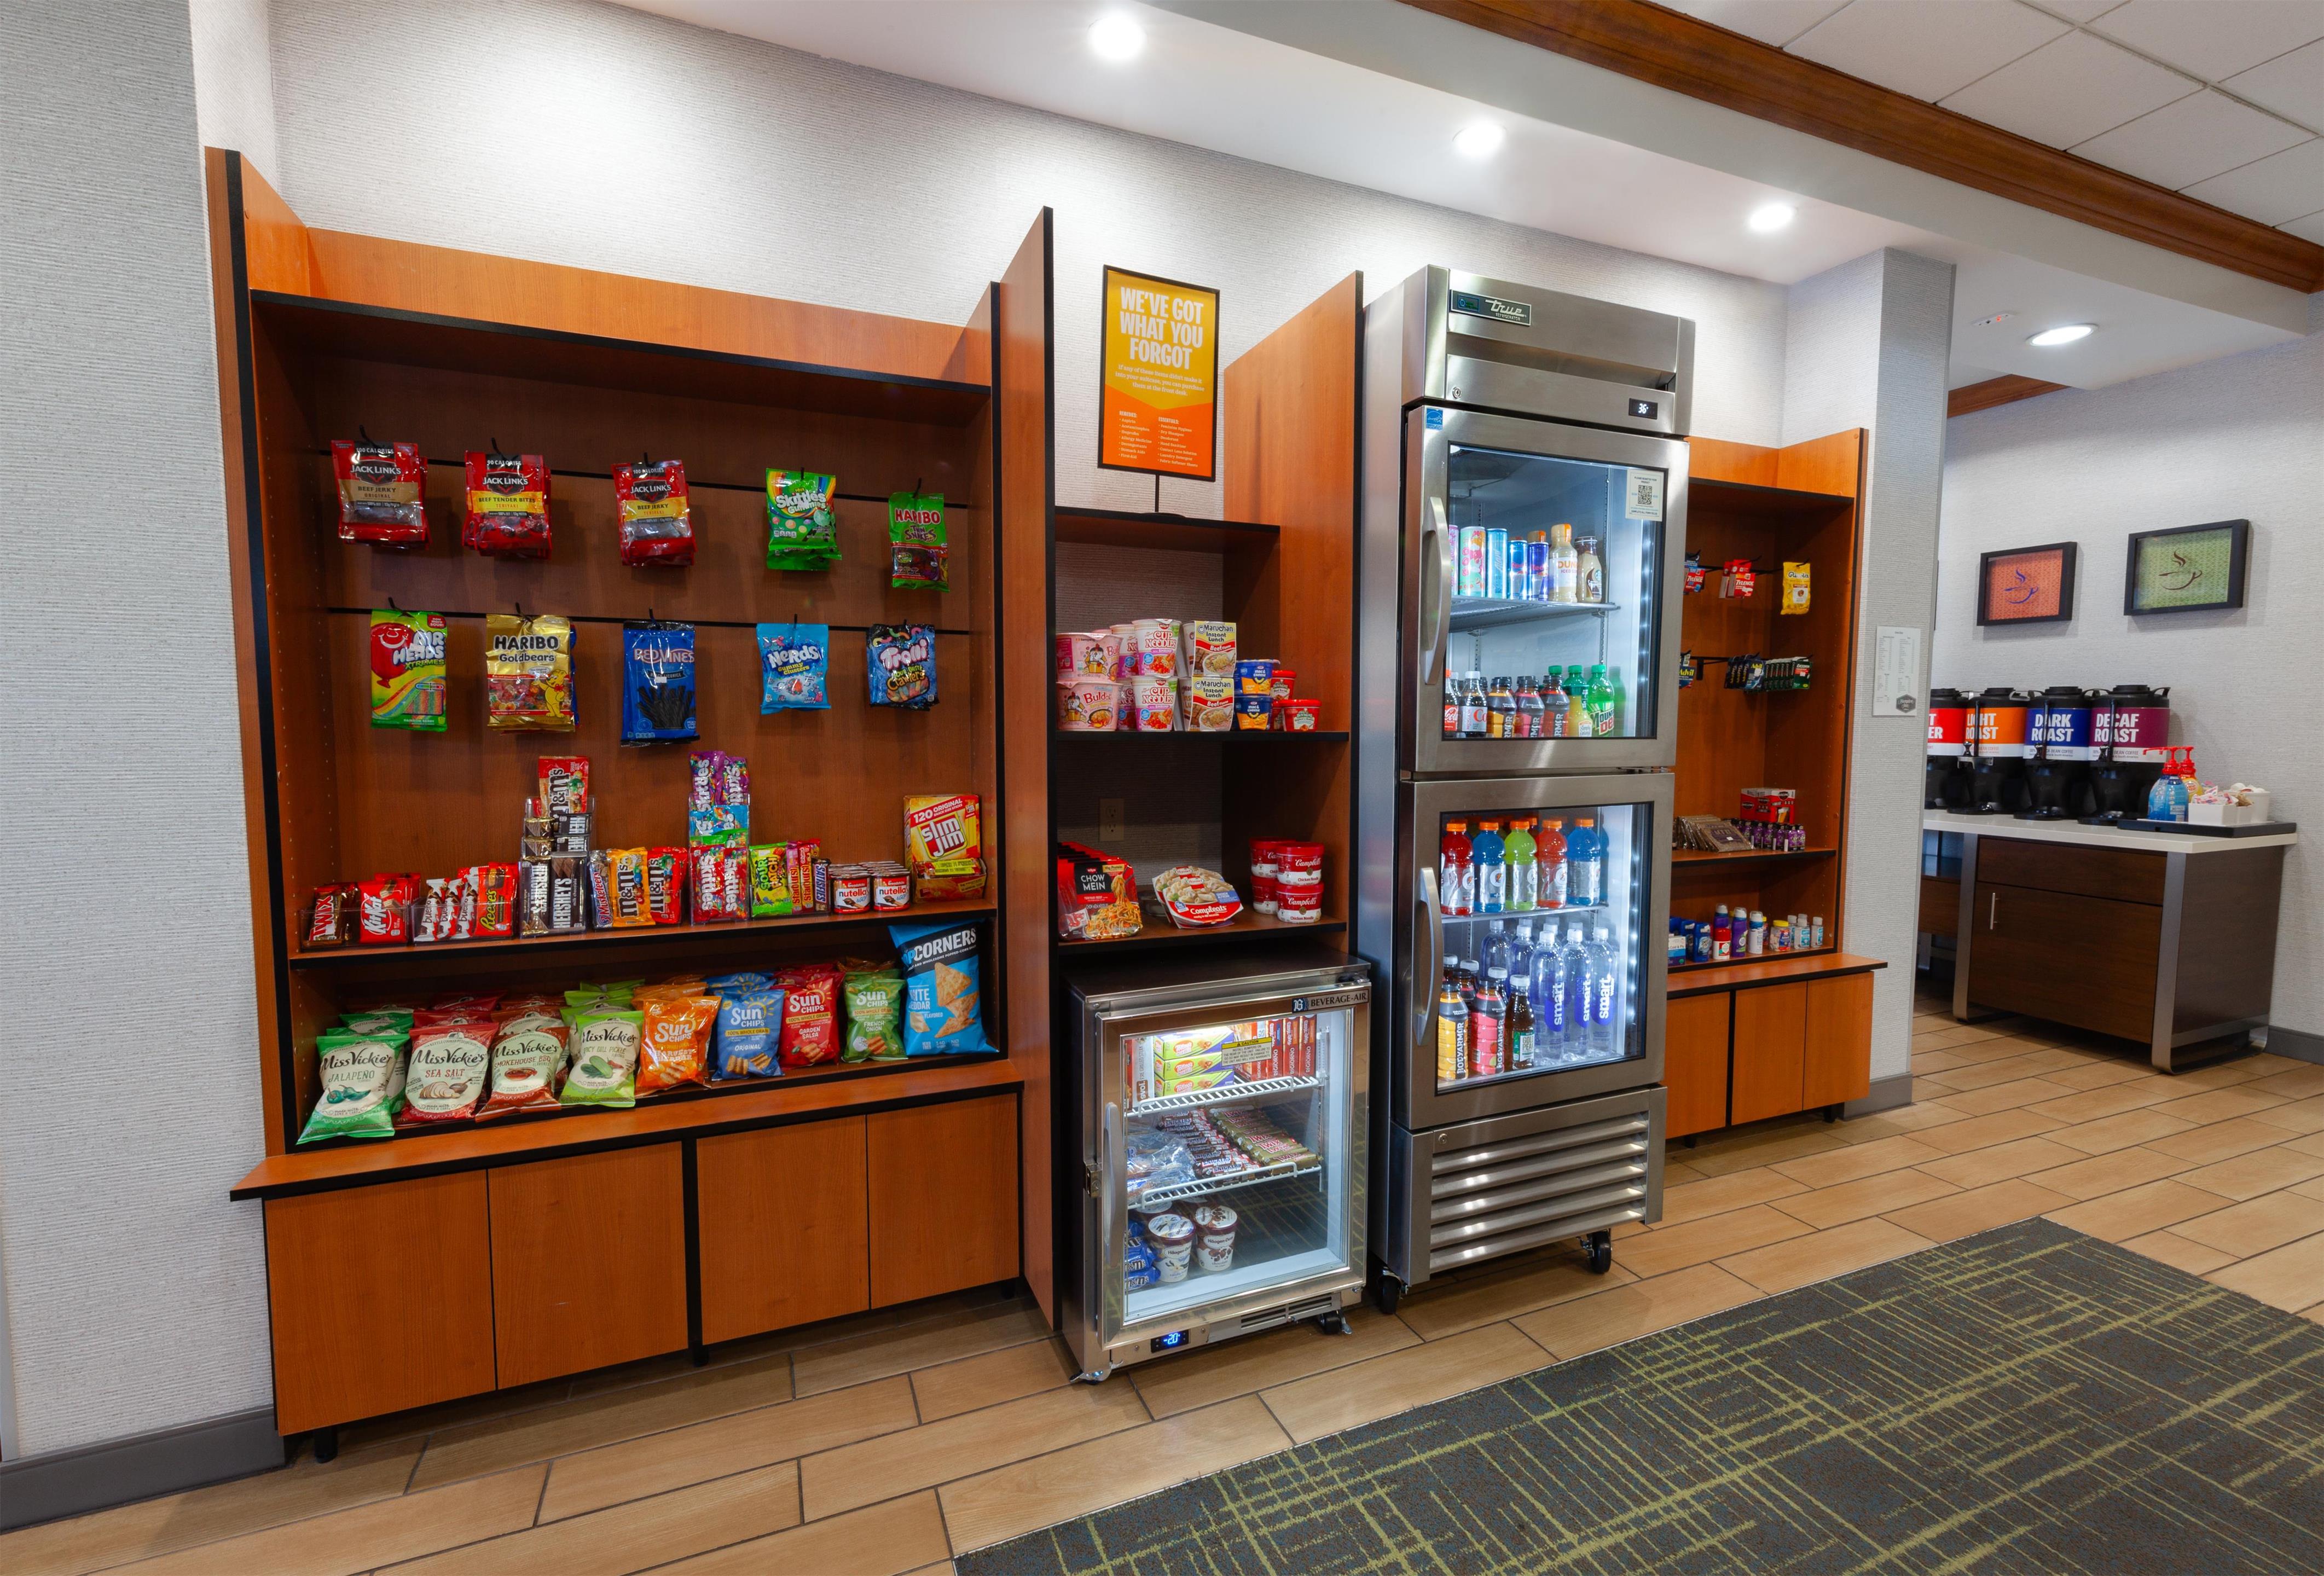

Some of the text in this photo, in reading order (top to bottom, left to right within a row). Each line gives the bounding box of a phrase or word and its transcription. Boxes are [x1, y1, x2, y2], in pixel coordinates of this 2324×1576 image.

[1120, 287, 1203, 324] WE'VE GOT
[1496, 312, 1521, 321] REFRIGERATOR
[1120, 311, 1203, 348] WHAT YOU
[1129, 337, 1192, 370] FORGOT
[350, 465, 401, 474] JACK LINK'S
[483, 477, 503, 485] JACK
[630, 486, 650, 494] JACK
[775, 490, 826, 508] Skittles
[895, 508, 941, 525] HARIBO
[413, 630, 444, 646] AIR
[494, 635, 559, 650] HARIBO
[1153, 631, 1173, 640] CUP
[1145, 639, 1177, 648] NOODLES
[393, 645, 444, 665] HEADS
[500, 652, 555, 662] Goldbears
[660, 648, 695, 663] VINES
[879, 639, 929, 670] Trolli
[405, 659, 445, 670] XTREMES
[778, 662, 803, 672] Gummy
[784, 665, 810, 675] Clusters
[1143, 694, 1174, 704] NOODLES
[1150, 687, 1170, 696] CUP
[913, 798, 963, 824] 120 ORIGINAL
[759, 859, 770, 890] SOUR
[768, 856, 784, 889] PATCH
[1081, 874, 1105, 882] CHOW
[699, 854, 717, 911] Skittles
[724, 858, 739, 912] Skittles
[815, 865, 826, 903] SATISFIES
[1083, 882, 1105, 891] MEIN
[593, 871, 613, 924] 3 Musketeers
[839, 888, 867, 897] nutella
[879, 887, 906, 895] nutella
[459, 898, 468, 922] bueno
[553, 878, 572, 929] HERSHEY'S
[1190, 905, 1227, 915] Compleats
[309, 895, 334, 941] TWIX
[423, 900, 432, 923] bueno
[923, 948, 969, 965] WHOLESOME POPPED-CORN
[789, 995, 821, 1012] Sun
[856, 990, 886, 1006] Sun
[1310, 992, 1367, 1007] BEVERAGE-AIR
[1552, 983, 1563, 1025] smart
[1599, 976, 1610, 1019] smart
[731, 1007, 762, 1025] Sun
[801, 1005, 825, 1013] CHIPS
[654, 1017, 696, 1043] Sun
[799, 1025, 821, 1034] GARDEN
[669, 1033, 692, 1042] CHIPS
[495, 1040, 559, 1058] Miss Vickie's
[320, 1055, 351, 1074] Miss
[412, 1047, 484, 1067] Miss Vickie's
[328, 1070, 375, 1082] JALAPEÑO
[425, 1068, 465, 1077] SEA SALT
[1245, 1134, 1272, 1144] TWIX
[1255, 1139, 1283, 1150] TWIX
[1203, 1157, 1231, 1166] SNICKERS
[1273, 1152, 1301, 1162] TWIX
[1214, 1163, 1242, 1172] SNICKERS
